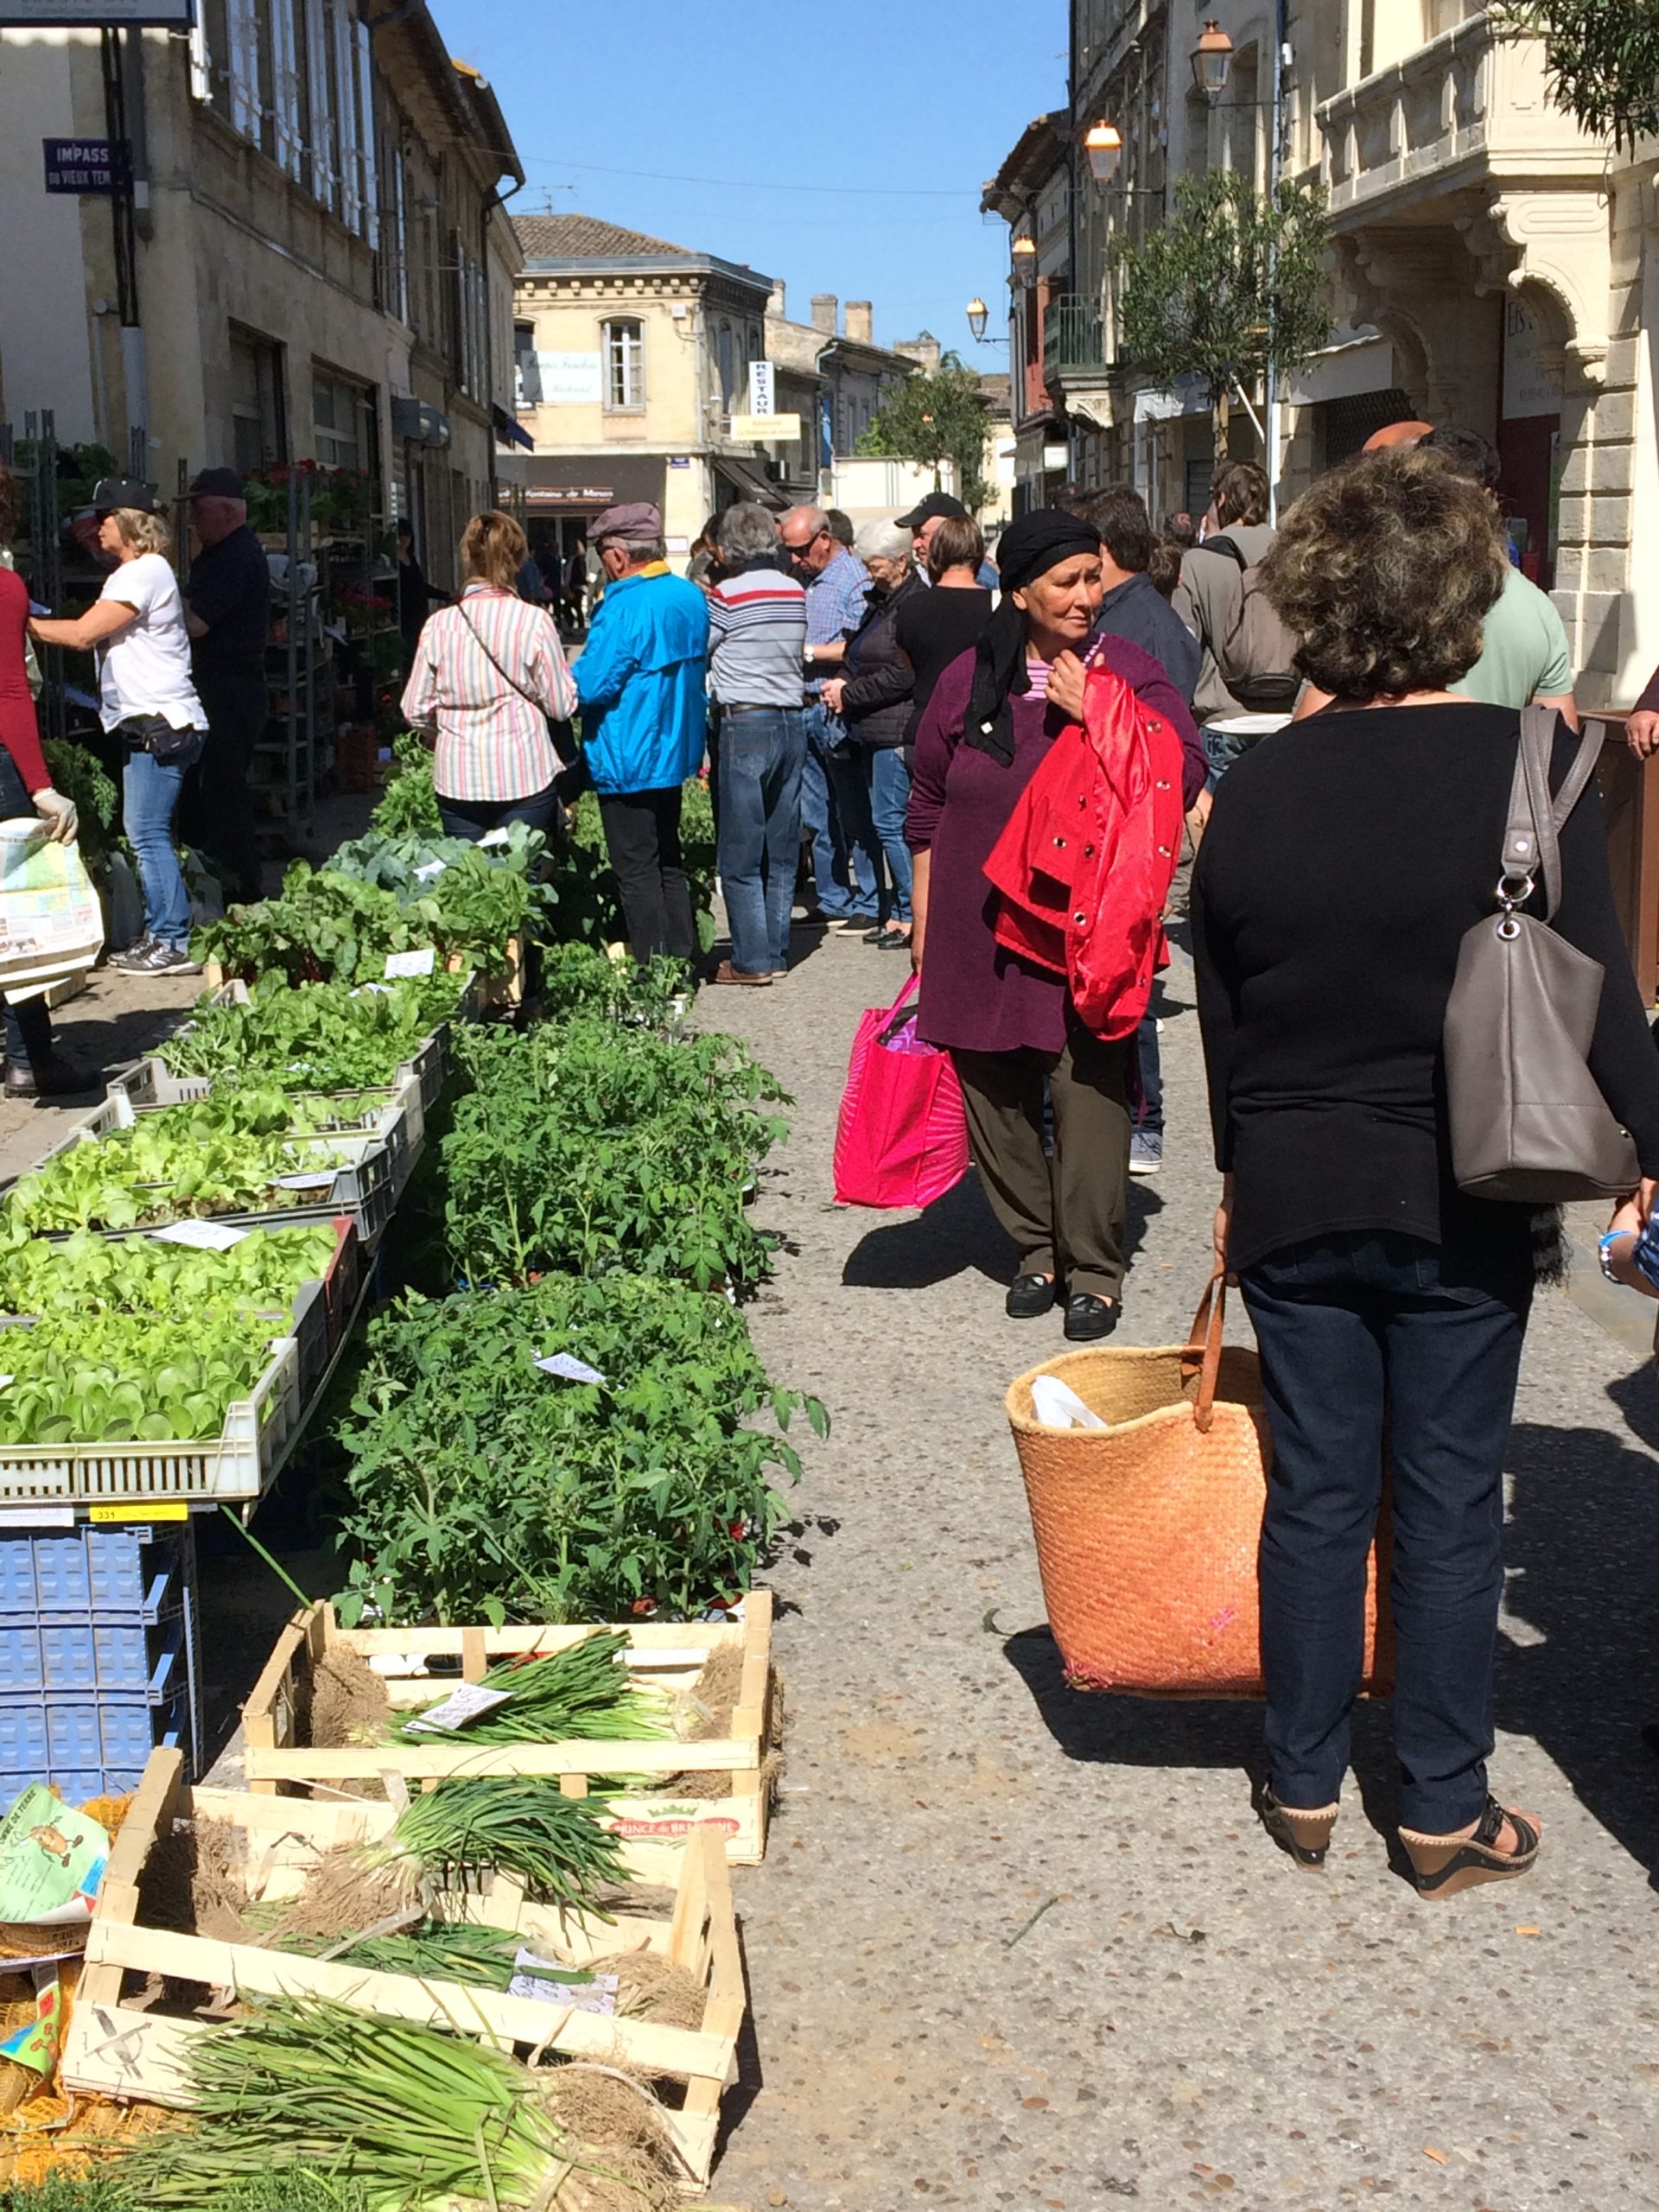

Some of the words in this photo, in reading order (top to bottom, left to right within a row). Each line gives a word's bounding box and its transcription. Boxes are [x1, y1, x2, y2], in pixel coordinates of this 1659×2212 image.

[56, 148, 110, 162] IMPASS
[91, 170, 111, 185] TEM
[756, 364, 768, 415] RESTAUR
[17, 1788, 37, 1813] TERRE
